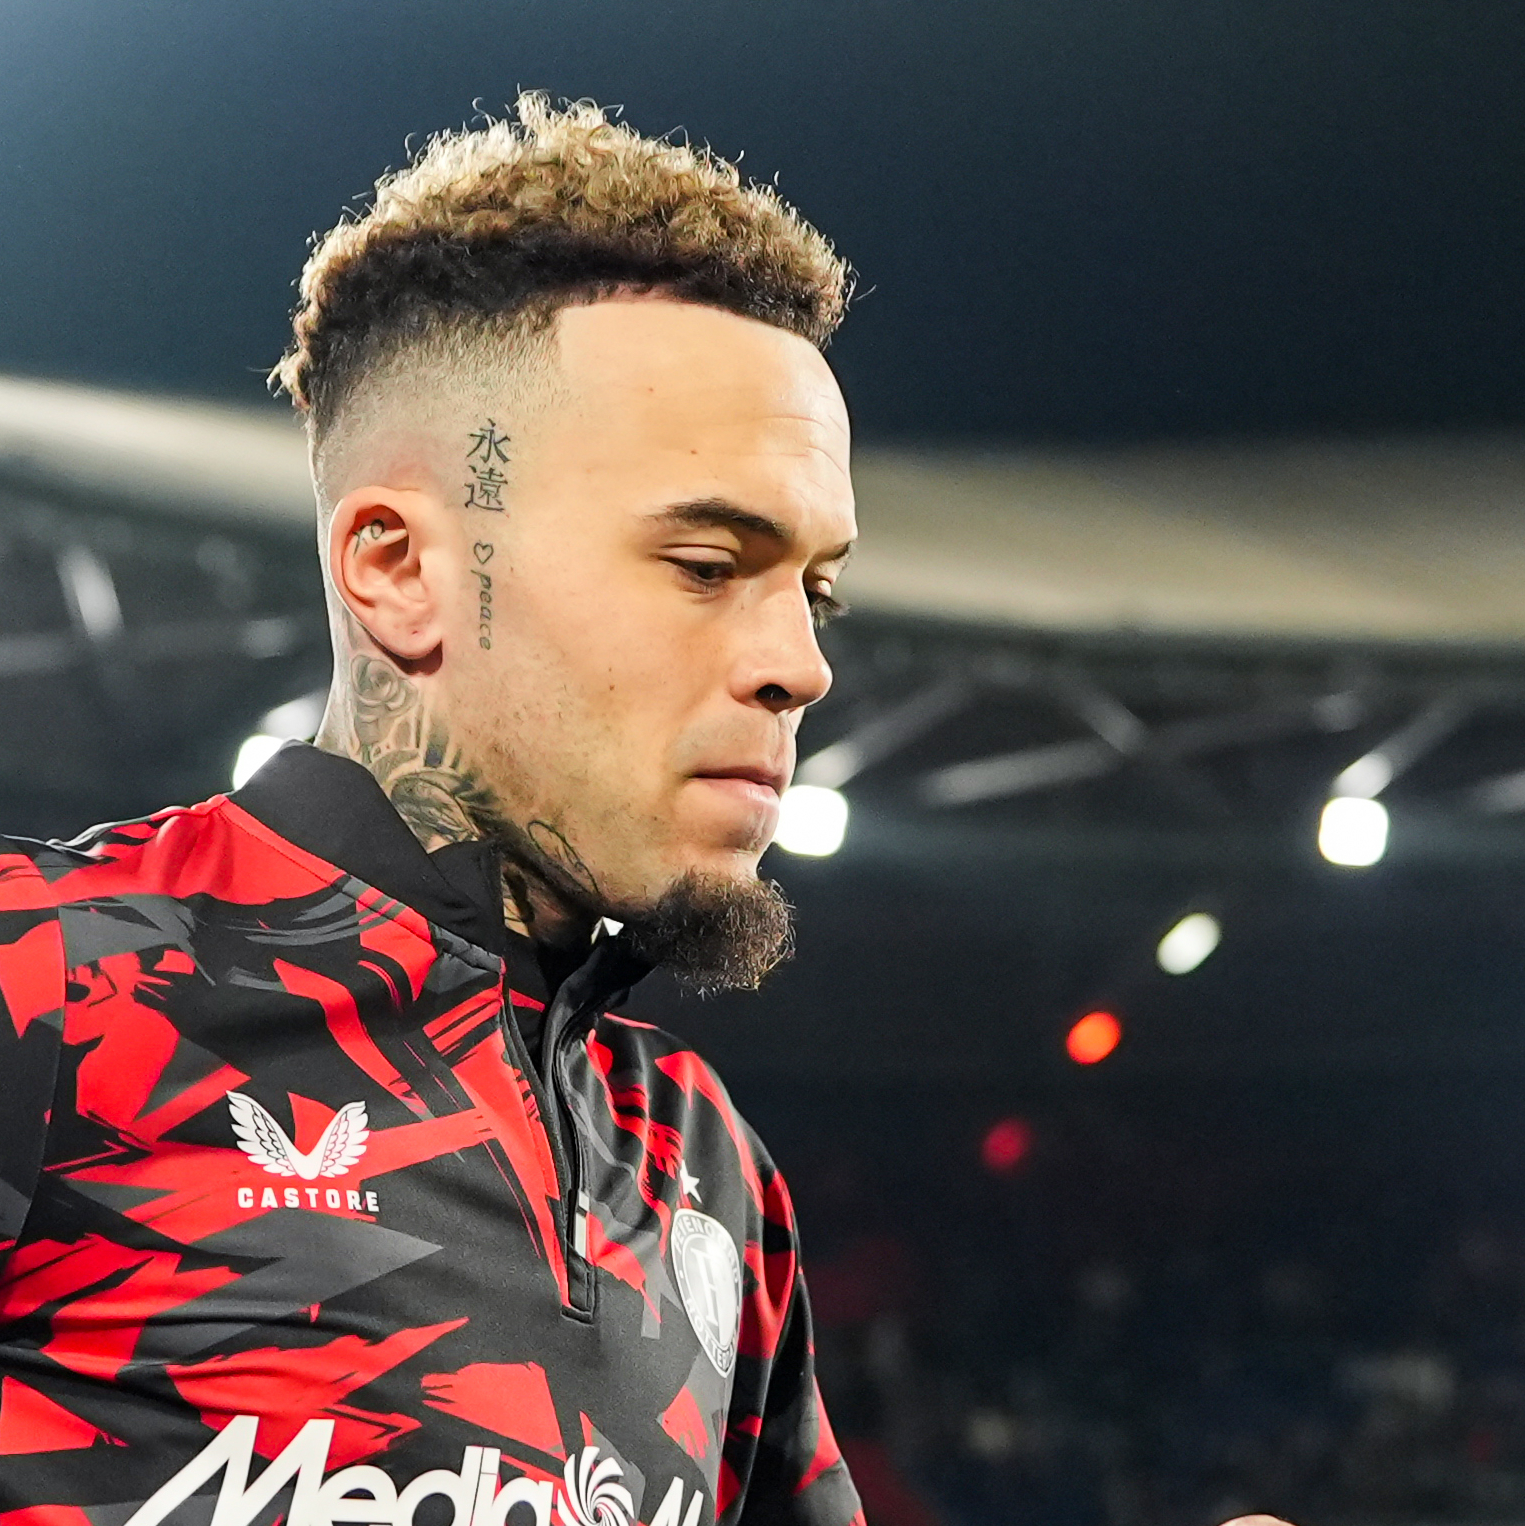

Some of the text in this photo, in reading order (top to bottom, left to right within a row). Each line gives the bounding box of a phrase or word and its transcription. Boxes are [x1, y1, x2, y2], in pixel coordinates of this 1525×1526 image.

[464, 418, 511, 512] 永遠
[470, 569, 492, 651] peace
[236, 1185, 381, 1213] CASTORE
